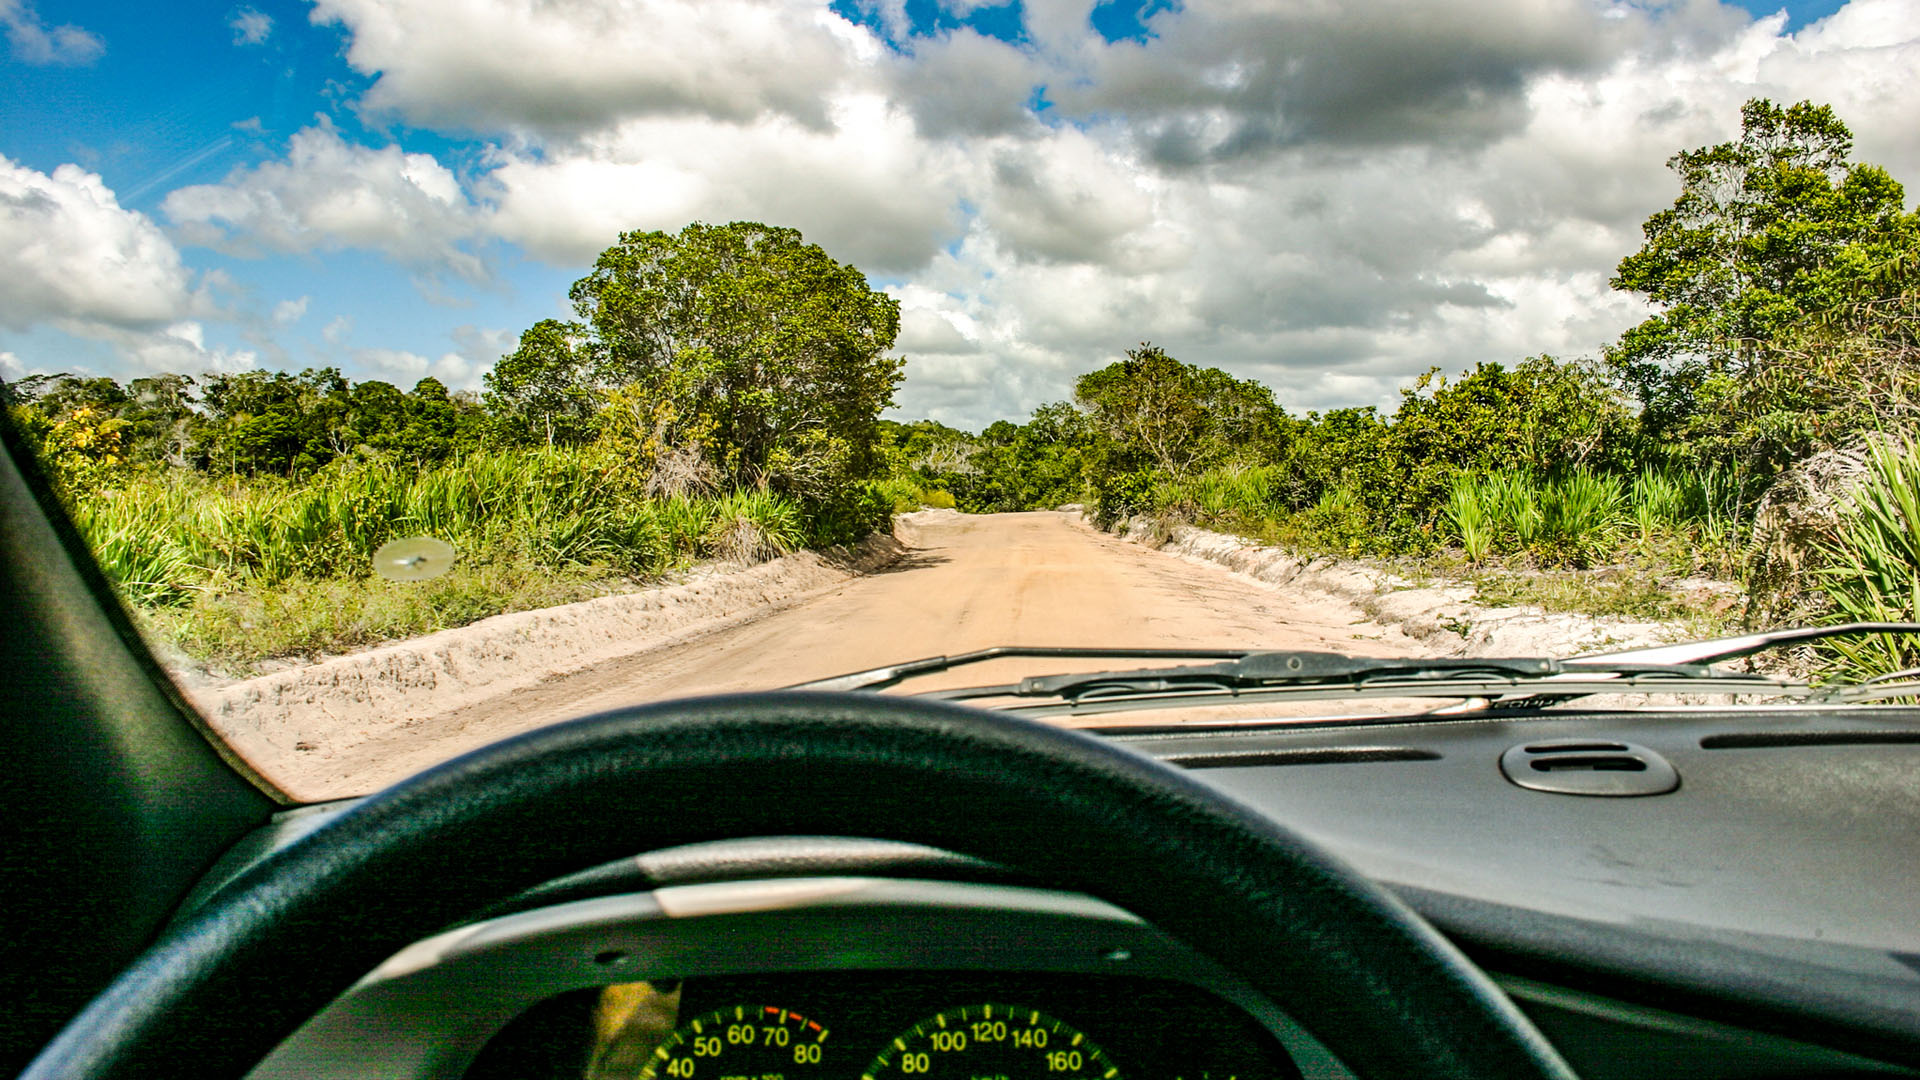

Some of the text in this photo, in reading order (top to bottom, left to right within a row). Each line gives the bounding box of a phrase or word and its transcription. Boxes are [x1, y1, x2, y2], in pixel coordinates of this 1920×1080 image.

[666, 1024, 821, 1078] 40 50 60 70 80
[901, 1021, 1082, 1073] 80 100 120 140 160
